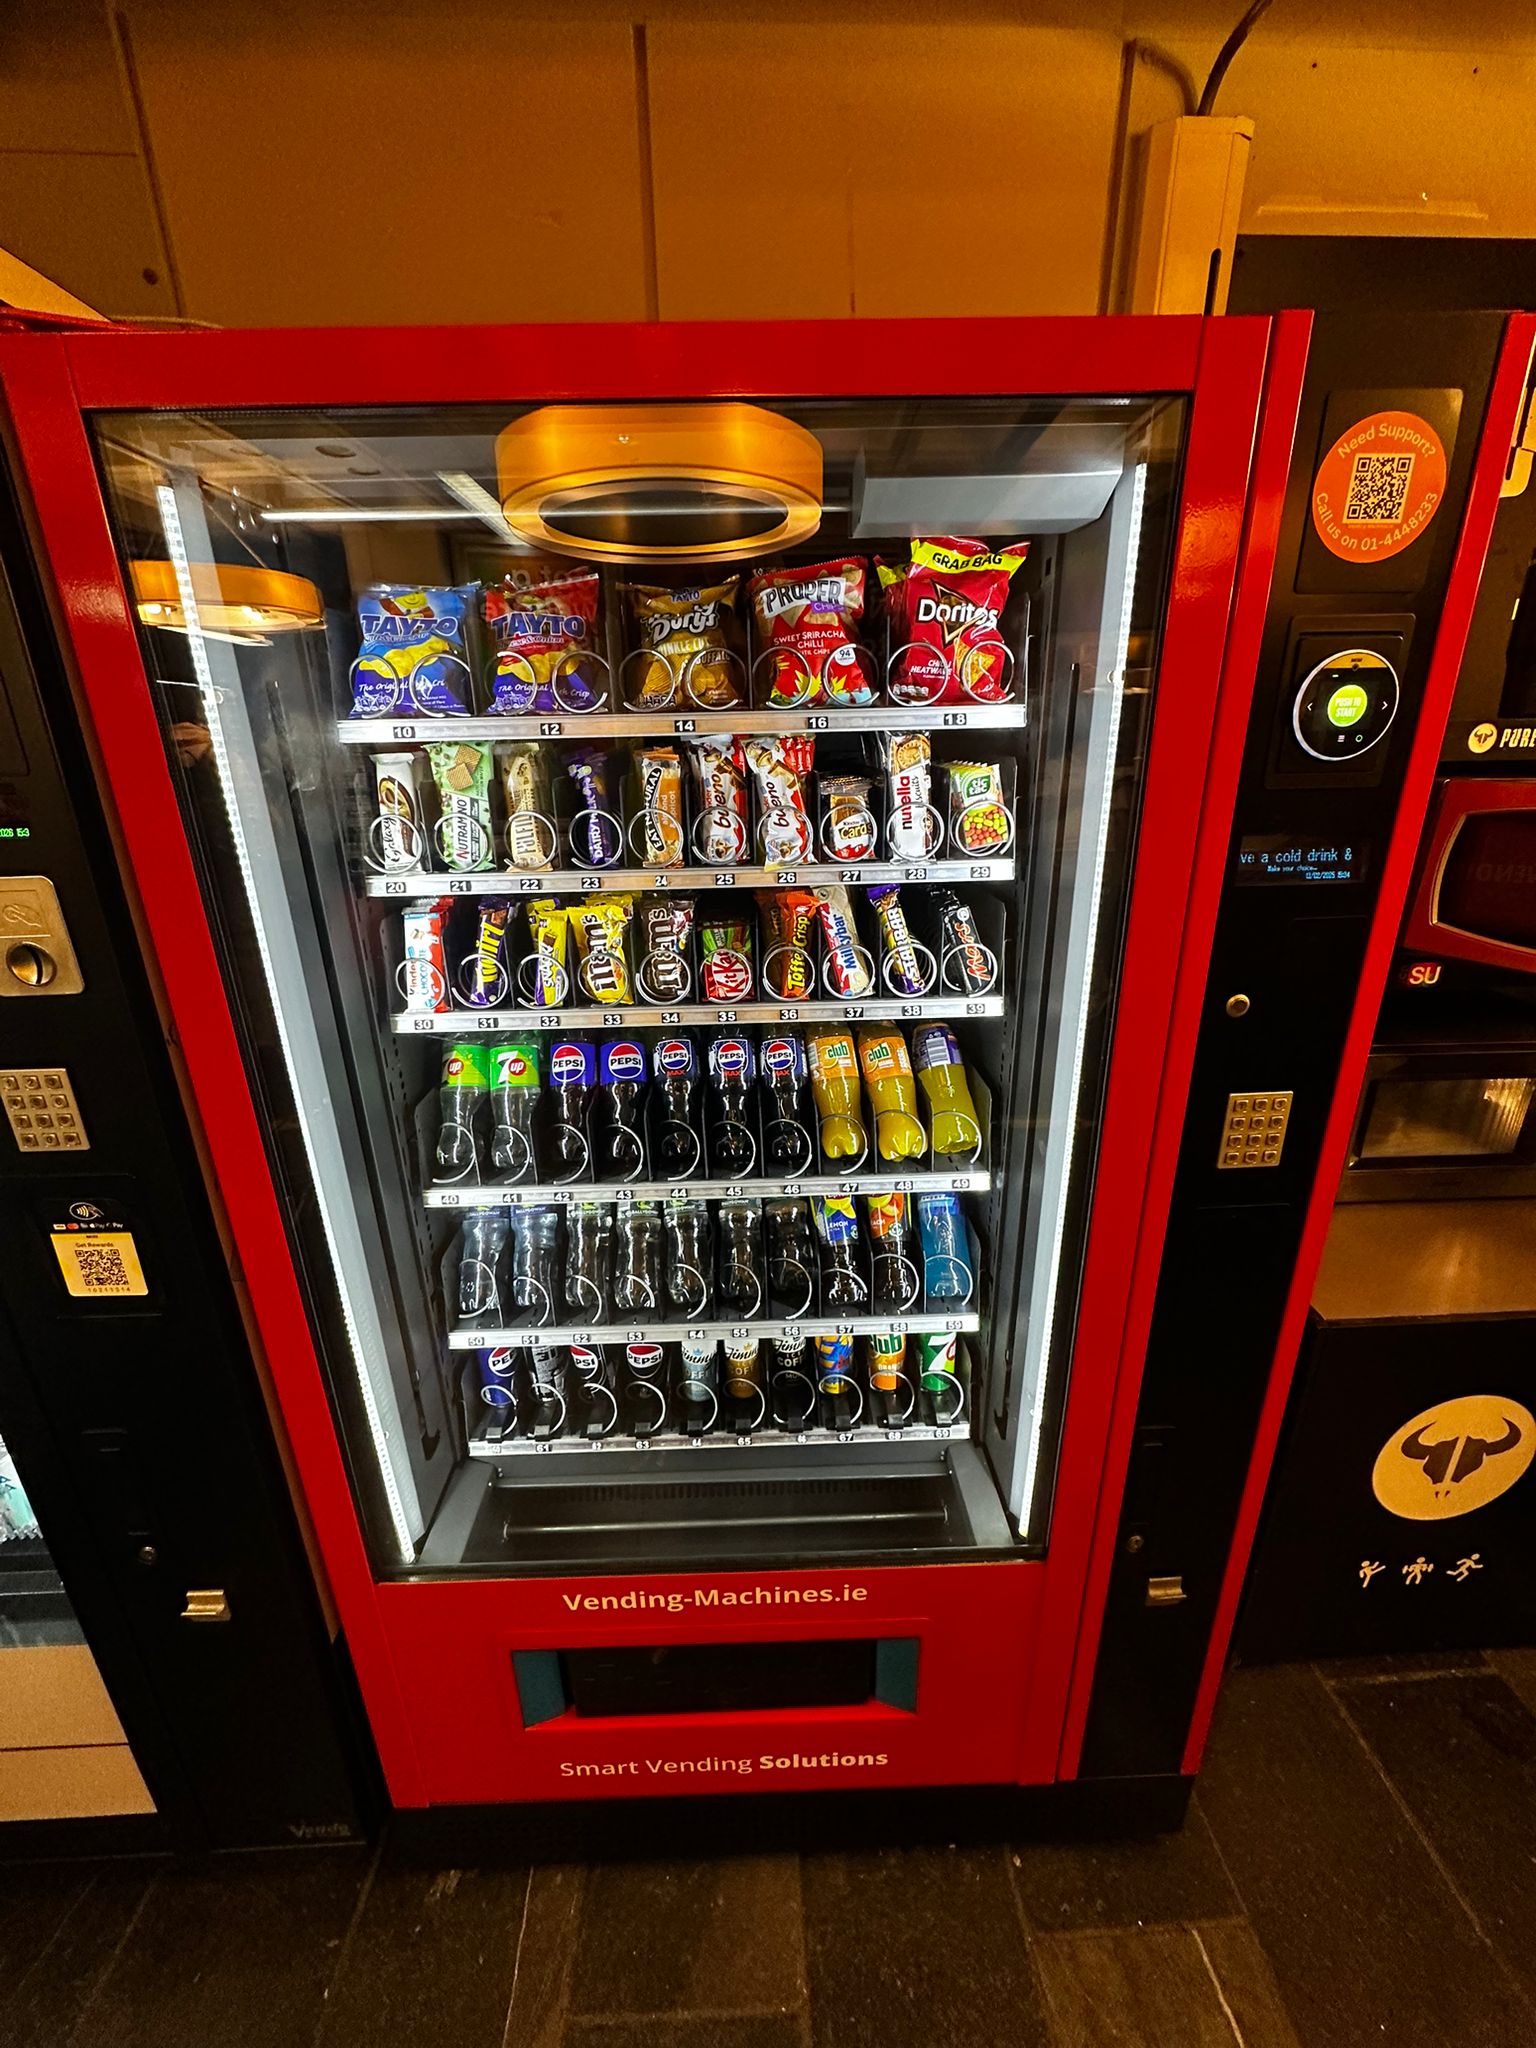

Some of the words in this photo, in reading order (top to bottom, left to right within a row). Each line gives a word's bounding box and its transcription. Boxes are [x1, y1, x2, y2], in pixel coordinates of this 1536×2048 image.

[1338, 425, 1375, 459] Need
[1379, 424, 1436, 458] Support?
[1317, 493, 1333, 524] Call
[1327, 523, 1342, 540] us
[1341, 535, 1358, 550] on
[1361, 493, 1438, 551] 01-4448233
[932, 552, 970, 570] GRAB
[972, 553, 1002, 567] BAG
[766, 580, 842, 613] PROPER
[918, 598, 999, 627] Doritos
[360, 613, 458, 636] TAYTO
[491, 611, 586, 639] TAYTO
[774, 634, 801, 646] SWEET
[802, 630, 846, 640] SRIRACHA
[797, 640, 824, 649] CHILLI
[911, 666, 952, 676] HEATWAVE
[359, 684, 374, 692] The
[498, 683, 513, 692] The
[570, 688, 591, 699] Crisp
[808, 717, 828, 728] 16
[945, 714, 966, 725] 18
[541, 723, 560, 735] 12
[676, 721, 695, 732] 14
[394, 728, 413, 739] 10
[1500, 728, 1536, 748] PURE
[970, 776, 989, 787] tic
[968, 785, 989, 797] tac
[712, 773, 732, 829] bueno
[766, 781, 790, 828] bueno
[897, 775, 913, 831] nutella
[456, 799, 470, 860] NUTRAMNO
[840, 822, 873, 841] Cards
[589, 824, 604, 859] DAIRY
[647, 829, 665, 850] EAT
[1240, 853, 1255, 864] ve
[1261, 853, 1269, 863] a
[1276, 849, 1302, 862] cold
[1307, 848, 1338, 861] drink
[1344, 847, 1353, 861] &
[778, 872, 796, 882] 26
[842, 871, 860, 881] 27
[908, 869, 926, 880] 28
[971, 867, 990, 878] 29
[521, 879, 539, 890] 22
[582, 877, 600, 888] 23
[655, 876, 668, 886] 24
[716, 874, 734, 885] 25
[387, 882, 405, 893] 20
[451, 881, 467, 892] 21
[793, 916, 811, 947] Crisp
[833, 914, 858, 970] Milkybar
[887, 907, 915, 980] STARBAR
[1409, 966, 1442, 984] SU
[846, 1008, 862, 1017] 37
[904, 1006, 921, 1015] 38
[968, 1004, 985, 1013] 39
[605, 1015, 621, 1024] 33
[662, 1013, 679, 1023] 34
[718, 1011, 735, 1021] 35
[781, 1010, 798, 1019] 36
[415, 1020, 432, 1029] 30
[480, 1018, 494, 1028] 31
[541, 1017, 558, 1026] 32
[767, 1051, 792, 1060] PEPSI
[827, 1042, 849, 1059] club
[868, 1044, 890, 1062] club
[663, 1052, 688, 1060] PEPSI
[719, 1052, 744, 1060] PEPSI
[553, 1058, 583, 1068] PEPSI
[610, 1057, 642, 1067] PEPSI
[842, 1183, 858, 1192] 47
[897, 1181, 912, 1190] 48
[954, 1179, 968, 1188] 49
[671, 1189, 687, 1198] 44
[726, 1187, 742, 1196] 45
[784, 1185, 800, 1193] 46
[443, 1195, 458, 1204] 40
[503, 1193, 518, 1203] 41
[554, 1192, 571, 1202] 42
[616, 1190, 632, 1199] 43
[827, 1220, 849, 1229] LEMON
[839, 1325, 853, 1334] 57
[893, 1323, 907, 1332] 58
[948, 1321, 962, 1330] 59
[628, 1332, 643, 1341] 53
[689, 1331, 704, 1339] 54
[733, 1329, 748, 1337] 55
[785, 1327, 799, 1336] 56
[469, 1337, 484, 1346] 50
[522, 1336, 535, 1344] 51
[574, 1334, 590, 1343] 52
[627, 1352, 662, 1366] PEPSI
[839, 1433, 853, 1442] 67
[888, 1432, 901, 1440] 68
[935, 1429, 949, 1437] 69
[636, 1440, 649, 1449] 63
[737, 1437, 751, 1446] 65
[536, 1444, 550, 1453] 61
[563, 1584, 868, 1612] Vending-Machines.ie
[560, 1760, 639, 1777] Smart
[645, 1757, 753, 1774] Vending
[759, 1753, 889, 1770] Solutions
